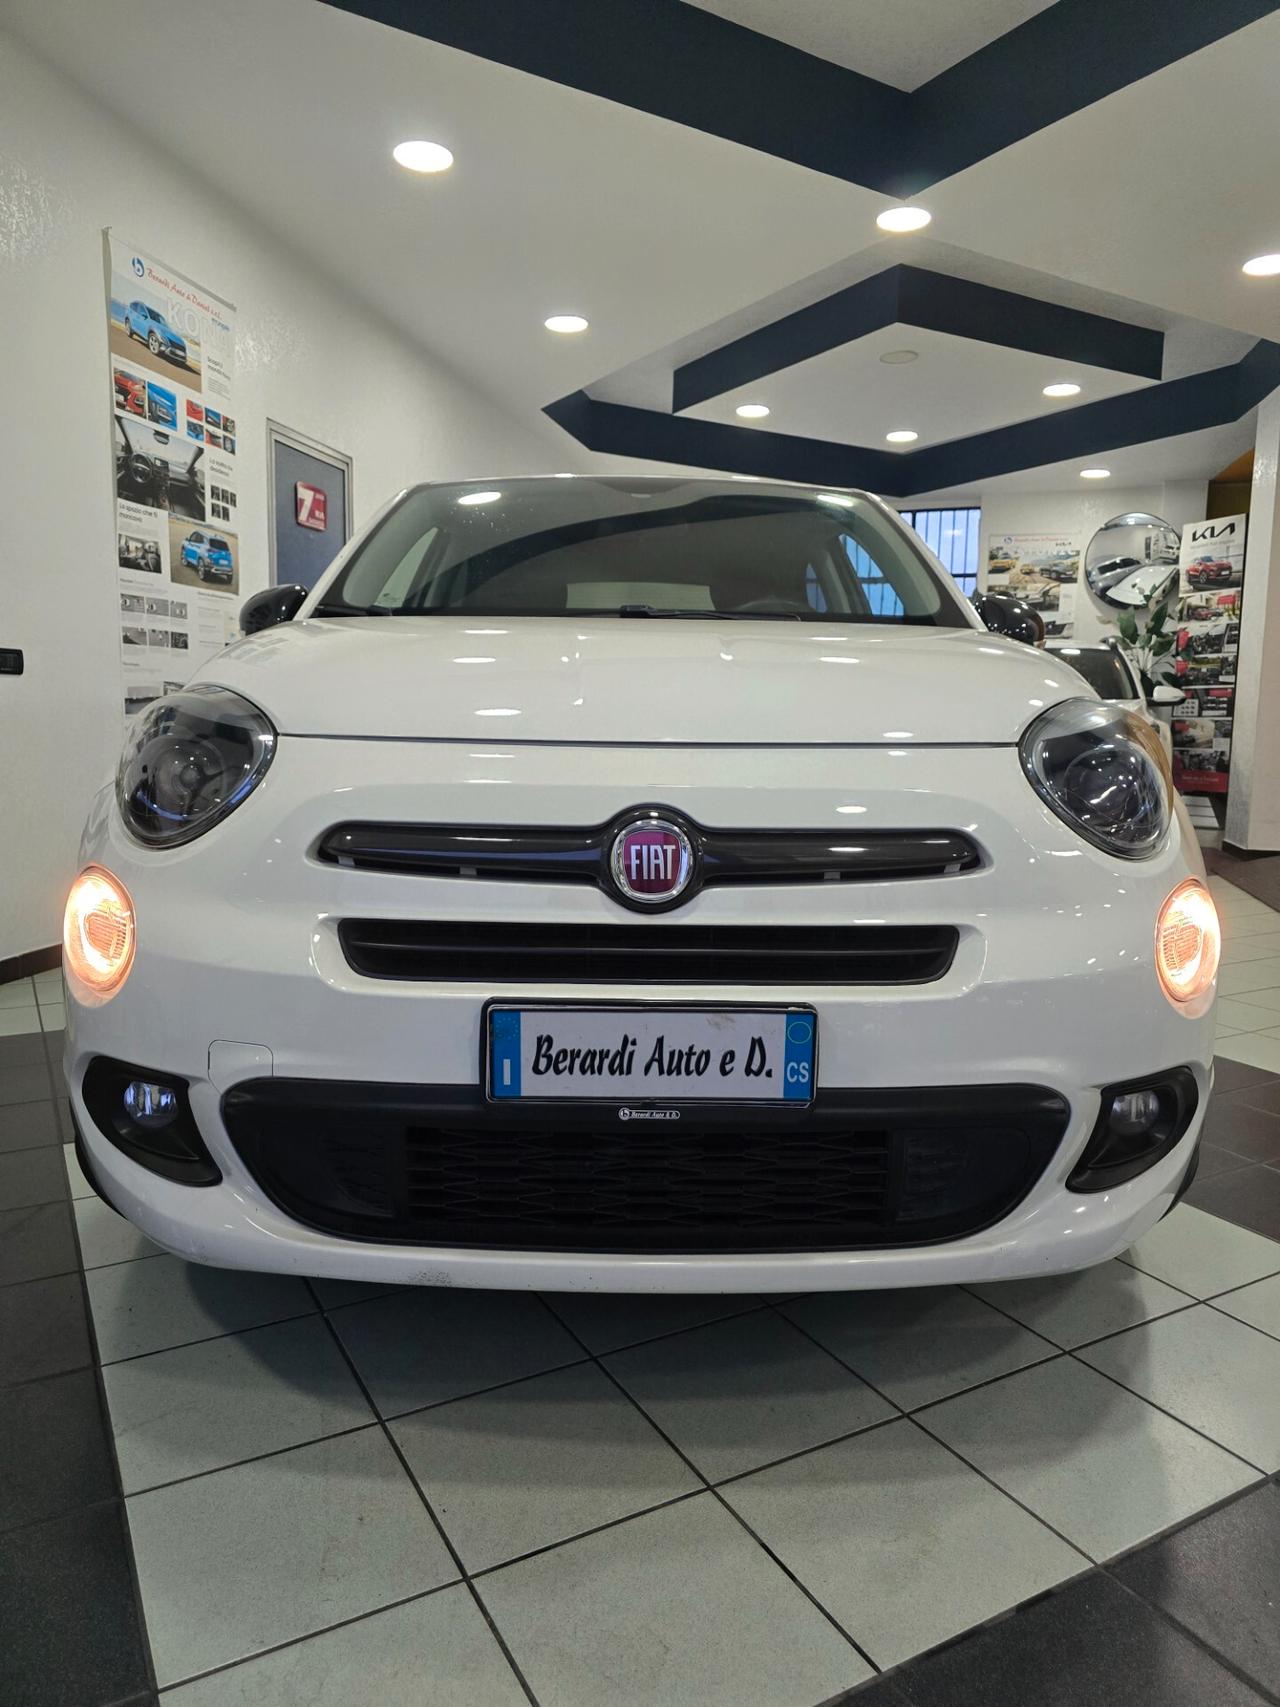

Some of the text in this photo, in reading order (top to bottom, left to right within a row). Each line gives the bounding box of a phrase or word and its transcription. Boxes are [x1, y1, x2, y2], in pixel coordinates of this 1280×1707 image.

[1191, 522, 1235, 542] KIA
[630, 844, 676, 880] FIAT
[531, 1034, 774, 1079] Berardi Auto e D.
[786, 1061, 809, 1083] CS
